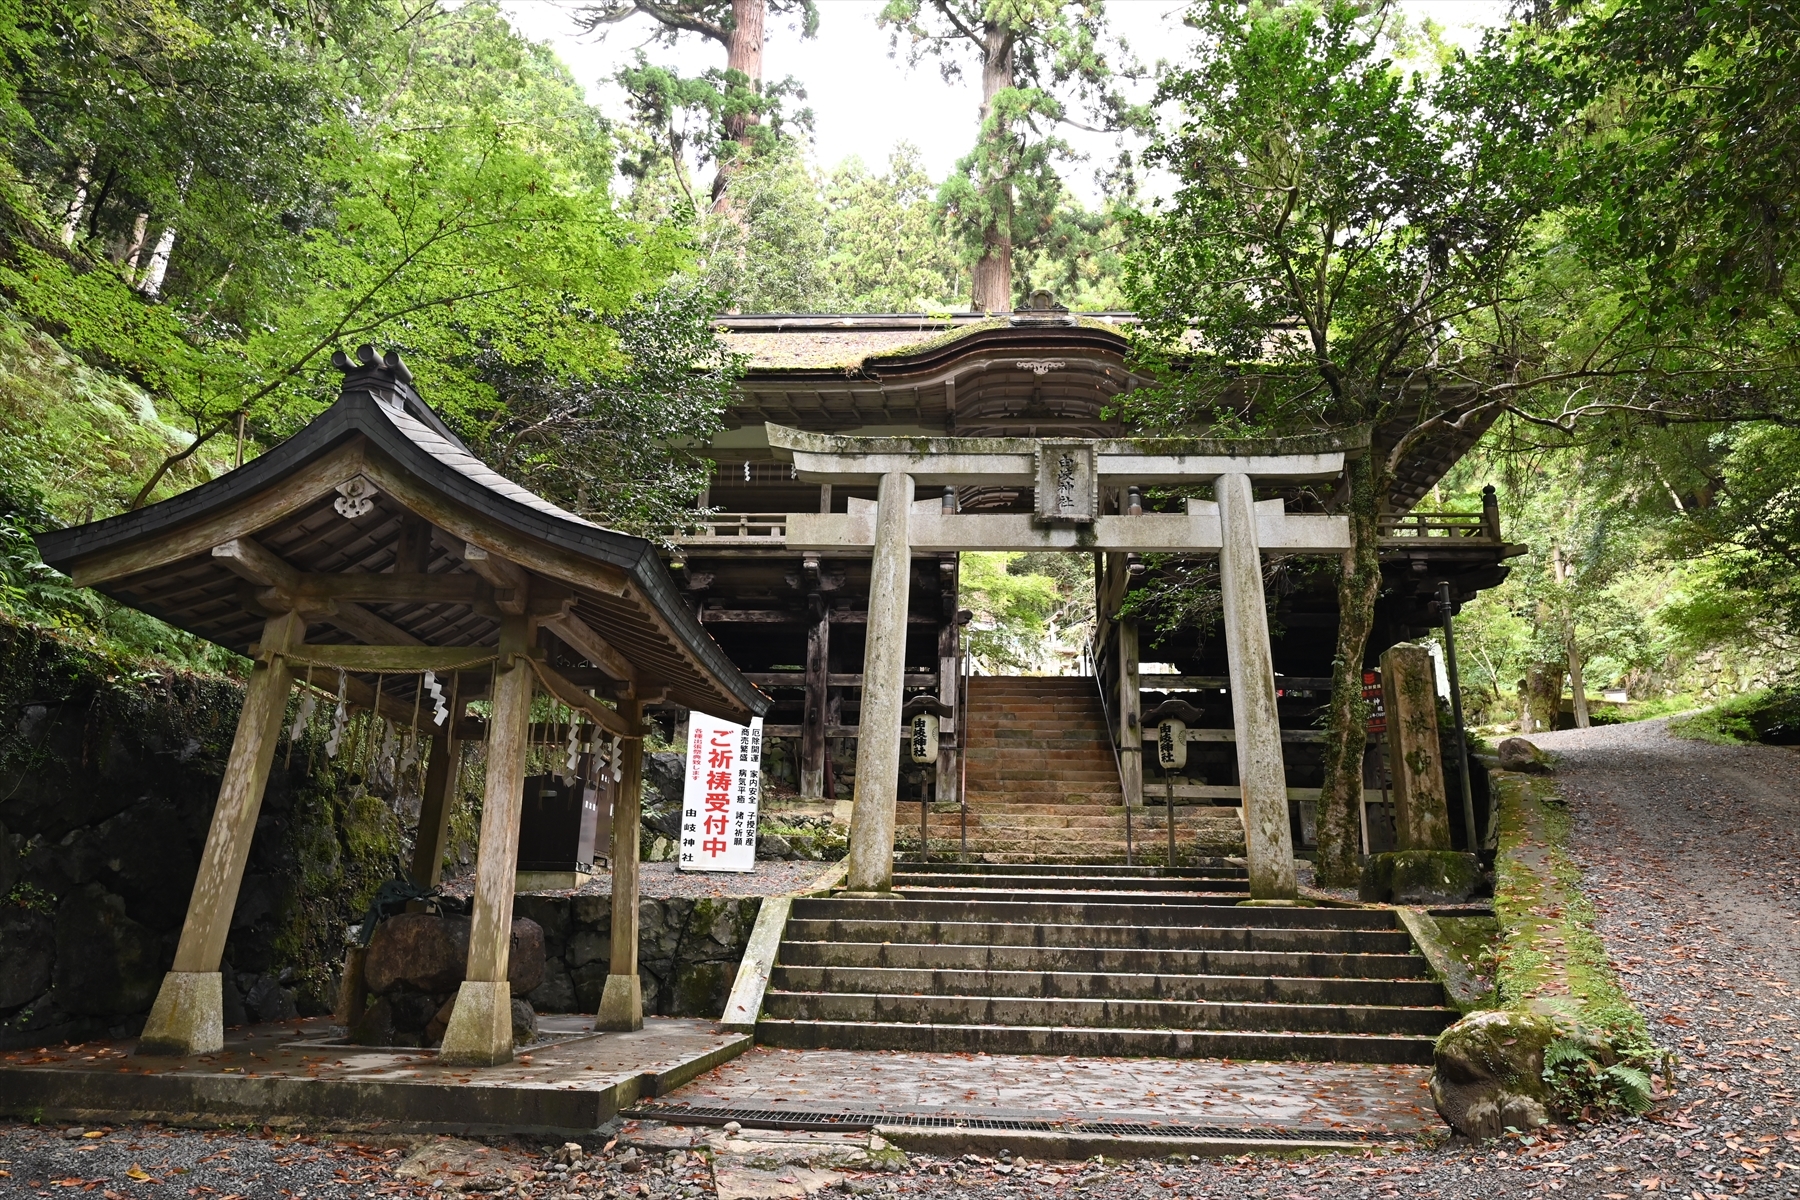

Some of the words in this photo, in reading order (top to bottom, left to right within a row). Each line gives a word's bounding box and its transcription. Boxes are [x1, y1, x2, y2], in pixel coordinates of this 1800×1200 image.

[1057, 453, 1075, 507] 由岐神社
[739, 727, 750, 762] 商売繁盛
[750, 728, 761, 763] 厄除開運
[913, 717, 927, 758] 由岐神社
[1159, 722, 1175, 763] 由岐神社
[702, 729, 734, 858] ご祈祷受付中
[736, 769, 747, 804] 病気平癒
[748, 770, 759, 805] 家内安全
[682, 808, 697, 862] 由岐神社
[733, 811, 744, 846] 諸々祈願
[745, 811, 756, 847] 子授安産
